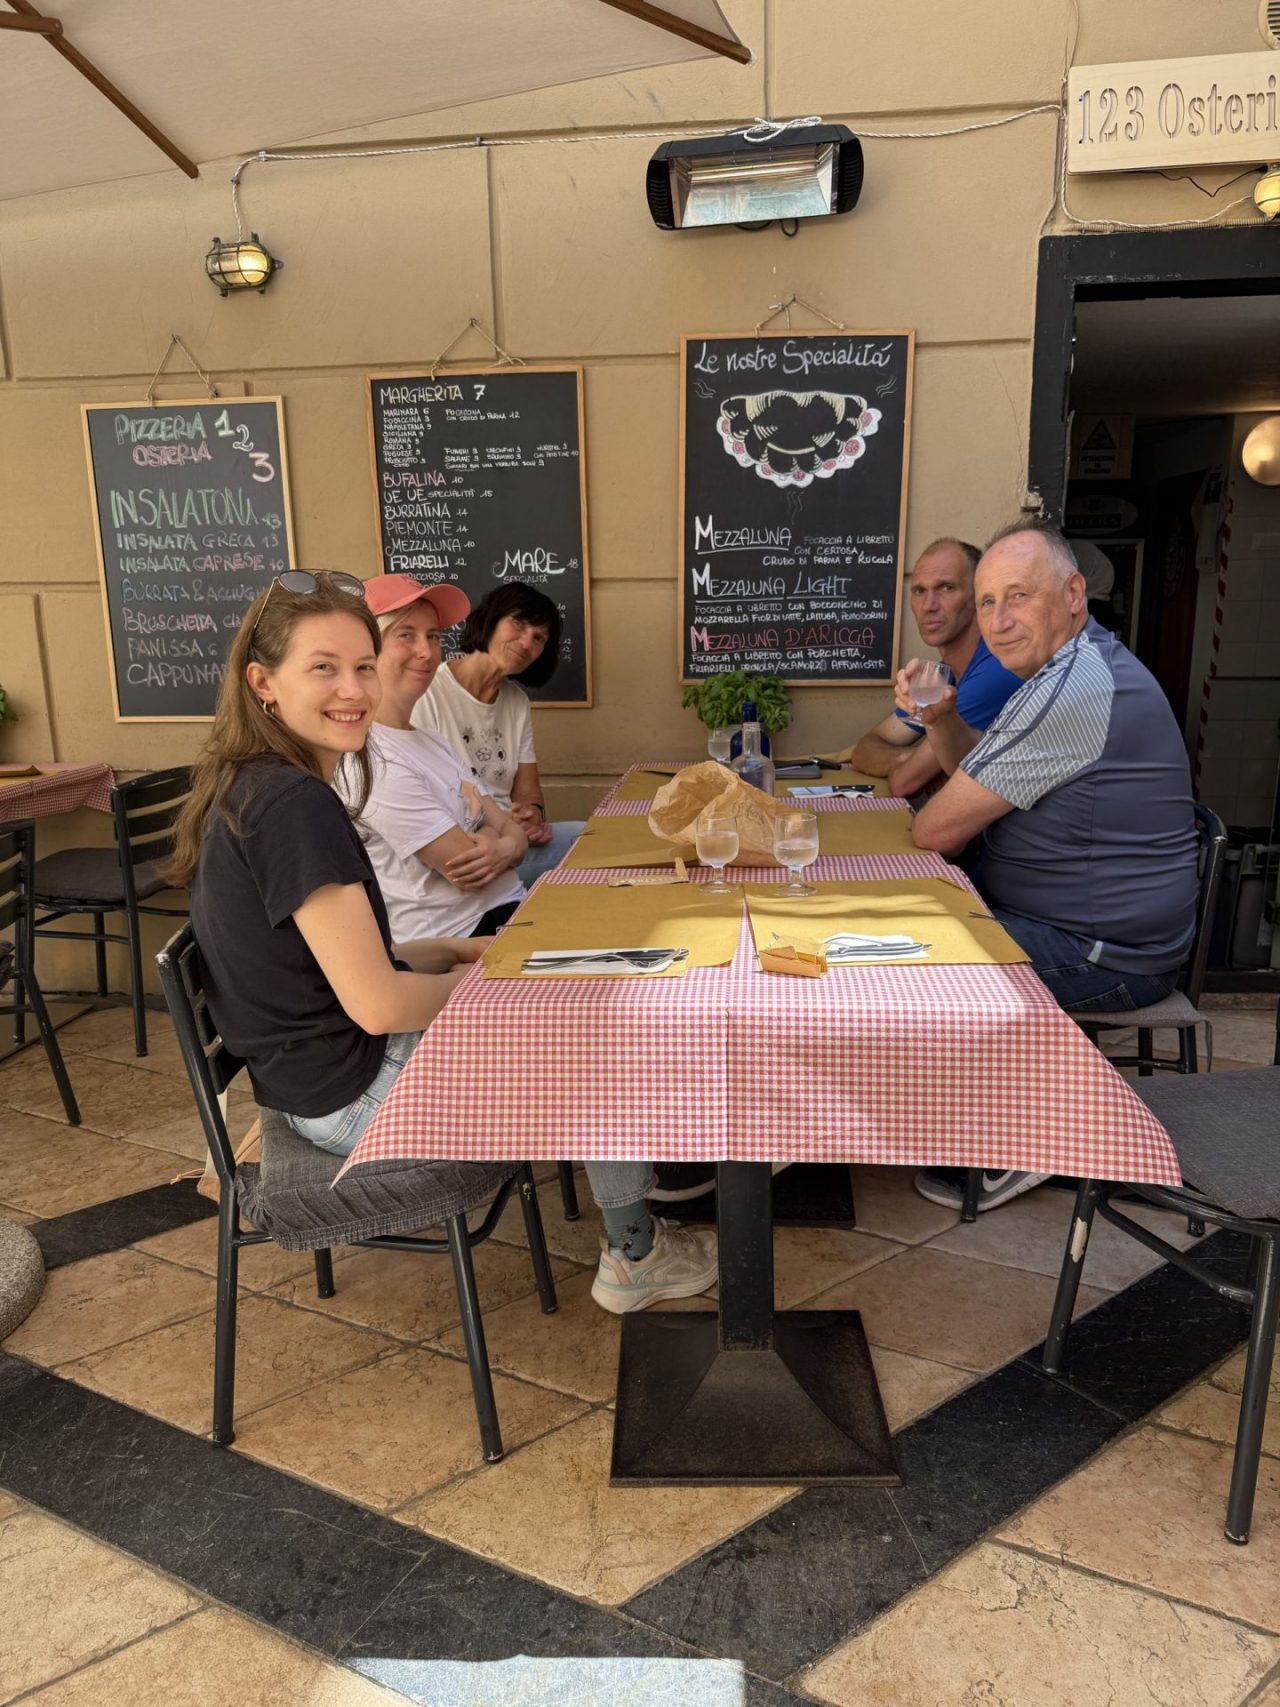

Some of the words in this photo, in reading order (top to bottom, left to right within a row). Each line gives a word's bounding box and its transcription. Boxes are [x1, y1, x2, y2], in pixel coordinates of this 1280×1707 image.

[1078, 86, 1145, 145] 123
[1158, 74, 1279, 139] Osteri
[694, 341, 720, 374] Le
[726, 344, 777, 372] nostre
[380, 384, 463, 405] MARGHERITA
[473, 384, 486, 400] 7
[383, 408, 420, 417] MARINARA
[383, 423, 425, 431] NAPOLETANA
[114, 411, 207, 445] PIZZERIA
[214, 409, 235, 437] 1
[232, 424, 254, 452] 2
[249, 452, 275, 482] 3
[132, 441, 214, 467] OSTERIA
[383, 470, 447, 488] BUFALINA
[451, 476, 463, 484] 10
[480, 490, 493, 498] 15
[110, 487, 259, 529] INSALATONA
[384, 502, 451, 520] BURRATINA
[386, 520, 453, 536] PIEMONTE
[694, 514, 792, 550] MEZZALUNA
[804, 535, 842, 545] FOCACCIA
[846, 535, 853, 544] A
[856, 535, 895, 544] LIBRETTO
[116, 532, 199, 553] INSALATA
[202, 530, 255, 549] GRECA
[385, 538, 461, 557] MEZZALUNA
[464, 540, 475, 548] 10
[794, 546, 811, 555] CON
[120, 554, 191, 574] INSALATA
[192, 552, 265, 572] CAPRESE
[269, 559, 285, 571] 10
[390, 554, 450, 571] FRIARELLI
[492, 547, 566, 578] MARE
[566, 558, 578, 568] 18
[762, 555, 796, 566] CRUDO
[799, 556, 808, 565] DI
[813, 555, 841, 565] PARMA
[845, 556, 853, 564] E
[858, 554, 893, 564] RUCOLA
[691, 562, 786, 598] MEZZALUNA
[793, 571, 853, 595] LIGHT
[694, 614, 749, 624] MOZZARELLA
[841, 611, 887, 620] POMODORINI
[695, 605, 732, 615] FOCACCIA
[736, 604, 743, 613] A
[748, 602, 783, 612] LIBRETTO
[788, 602, 805, 610] CON
[810, 600, 867, 610] BOCCONCINO
[872, 600, 883, 608] DI
[122, 606, 218, 634] BRUSCHETTA
[690, 625, 779, 652] MEZZALUNA
[128, 637, 204, 661] PANISSA
[691, 653, 730, 663] FOCACCIA
[734, 652, 740, 661] A
[744, 651, 783, 660] LIBRETTO
[786, 650, 804, 659] CON
[831, 659, 887, 670] AFFUMICATA
